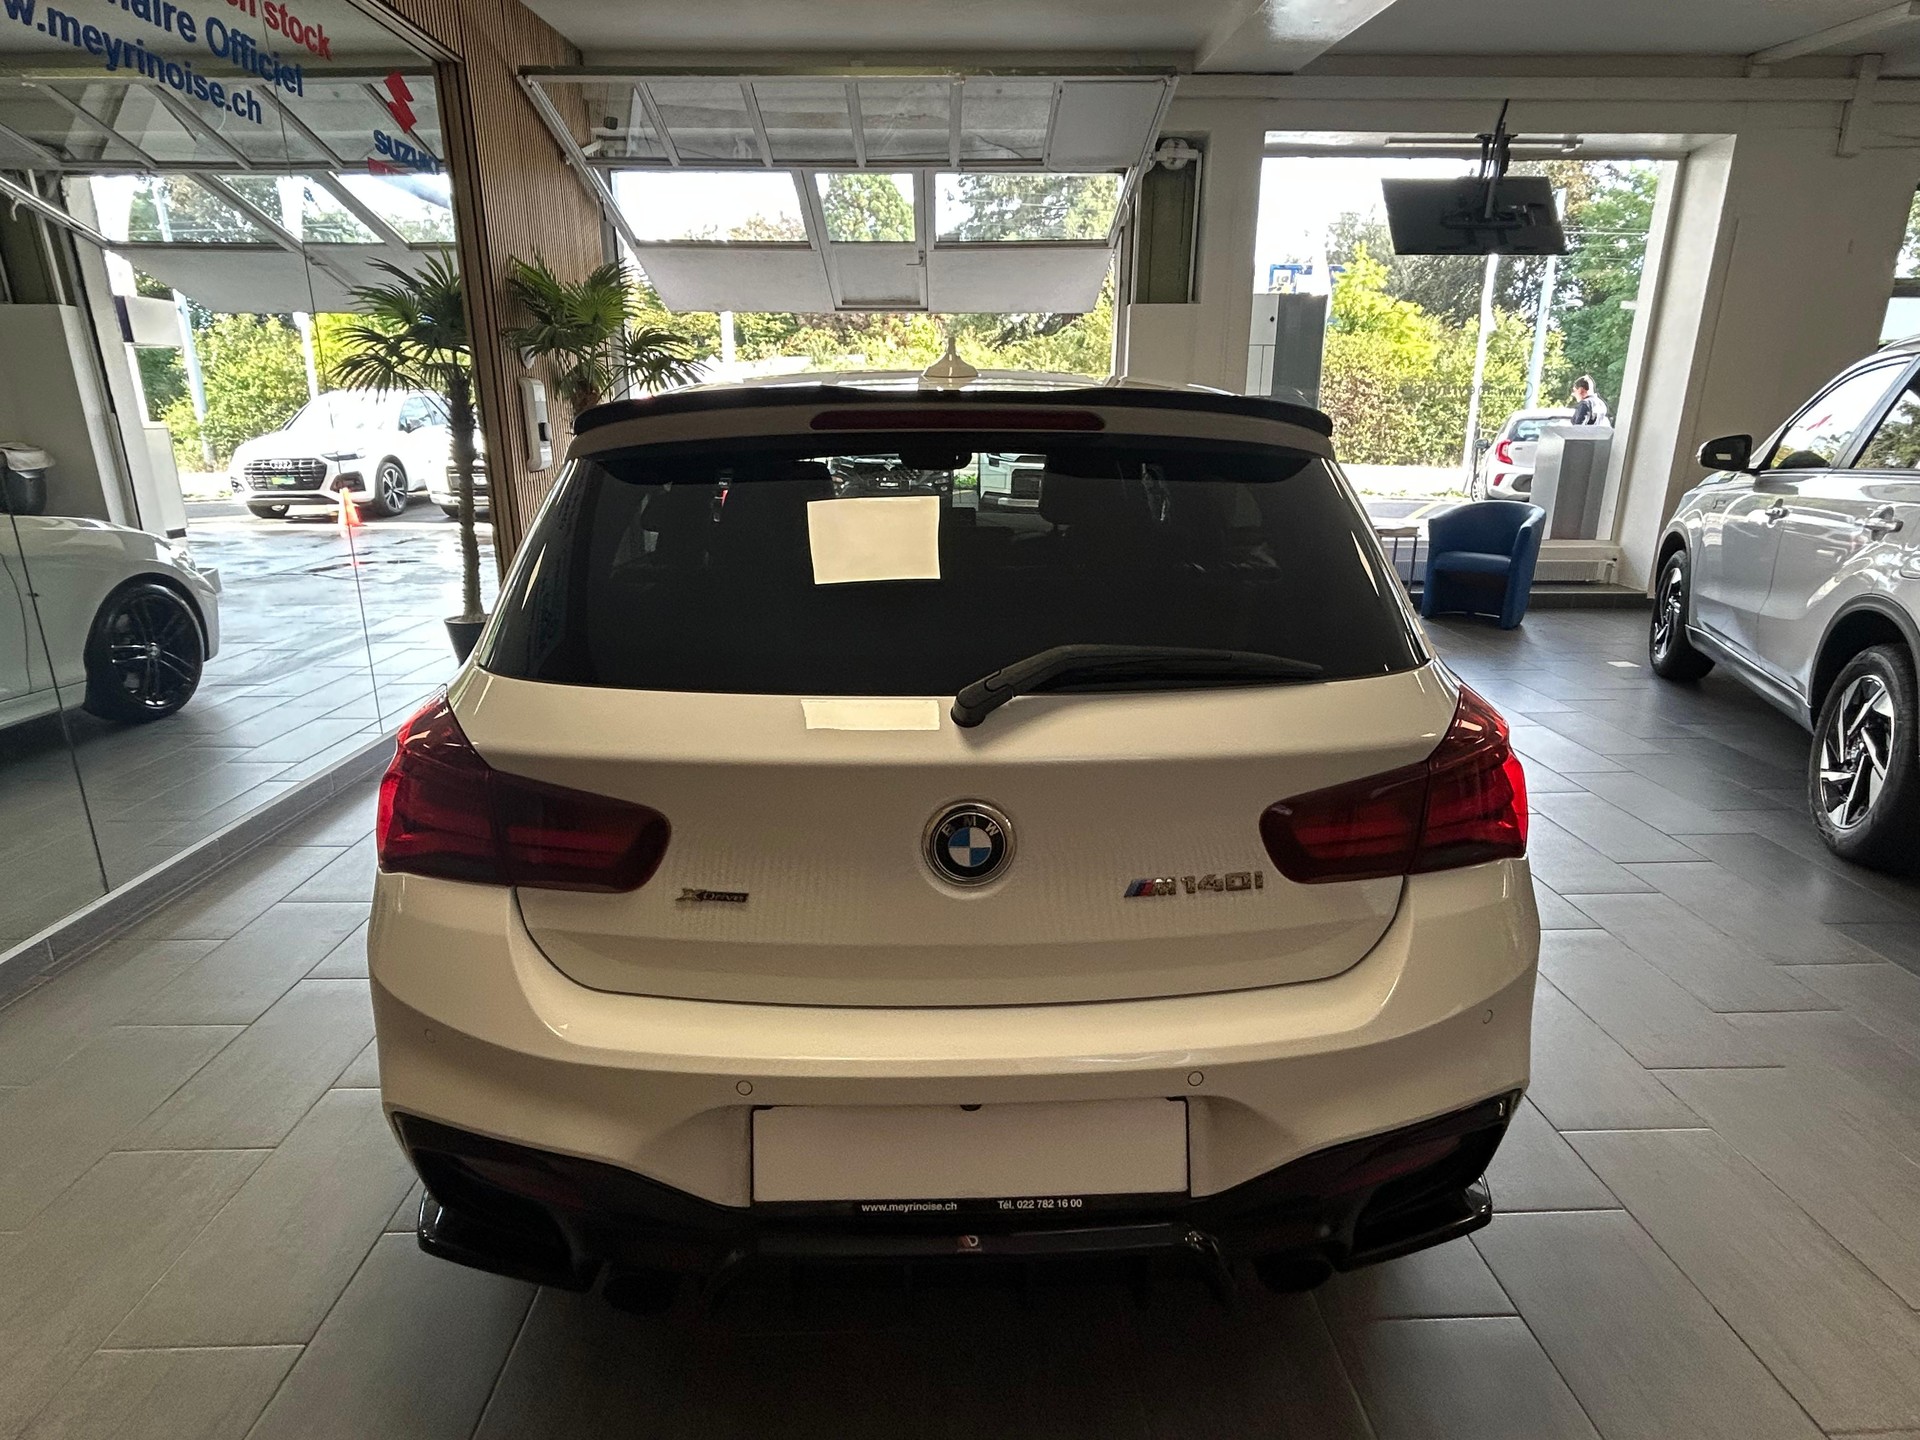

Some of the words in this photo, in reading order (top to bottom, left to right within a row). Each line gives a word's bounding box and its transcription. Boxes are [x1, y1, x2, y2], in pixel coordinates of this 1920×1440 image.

[264, 1, 332, 61] stock
[205, 16, 303, 97] Officiel
[941, 815, 1000, 837] BMW
[861, 1202, 958, 1213] www.meyrinoise.ch
[997, 1200, 1015, 1210] Tél.
[1016, 1200, 1035, 1209] 022
[1037, 1199, 1055, 1209] 782
[1057, 1199, 1069, 1208] 16
[1070, 1198, 1083, 1208] 00
